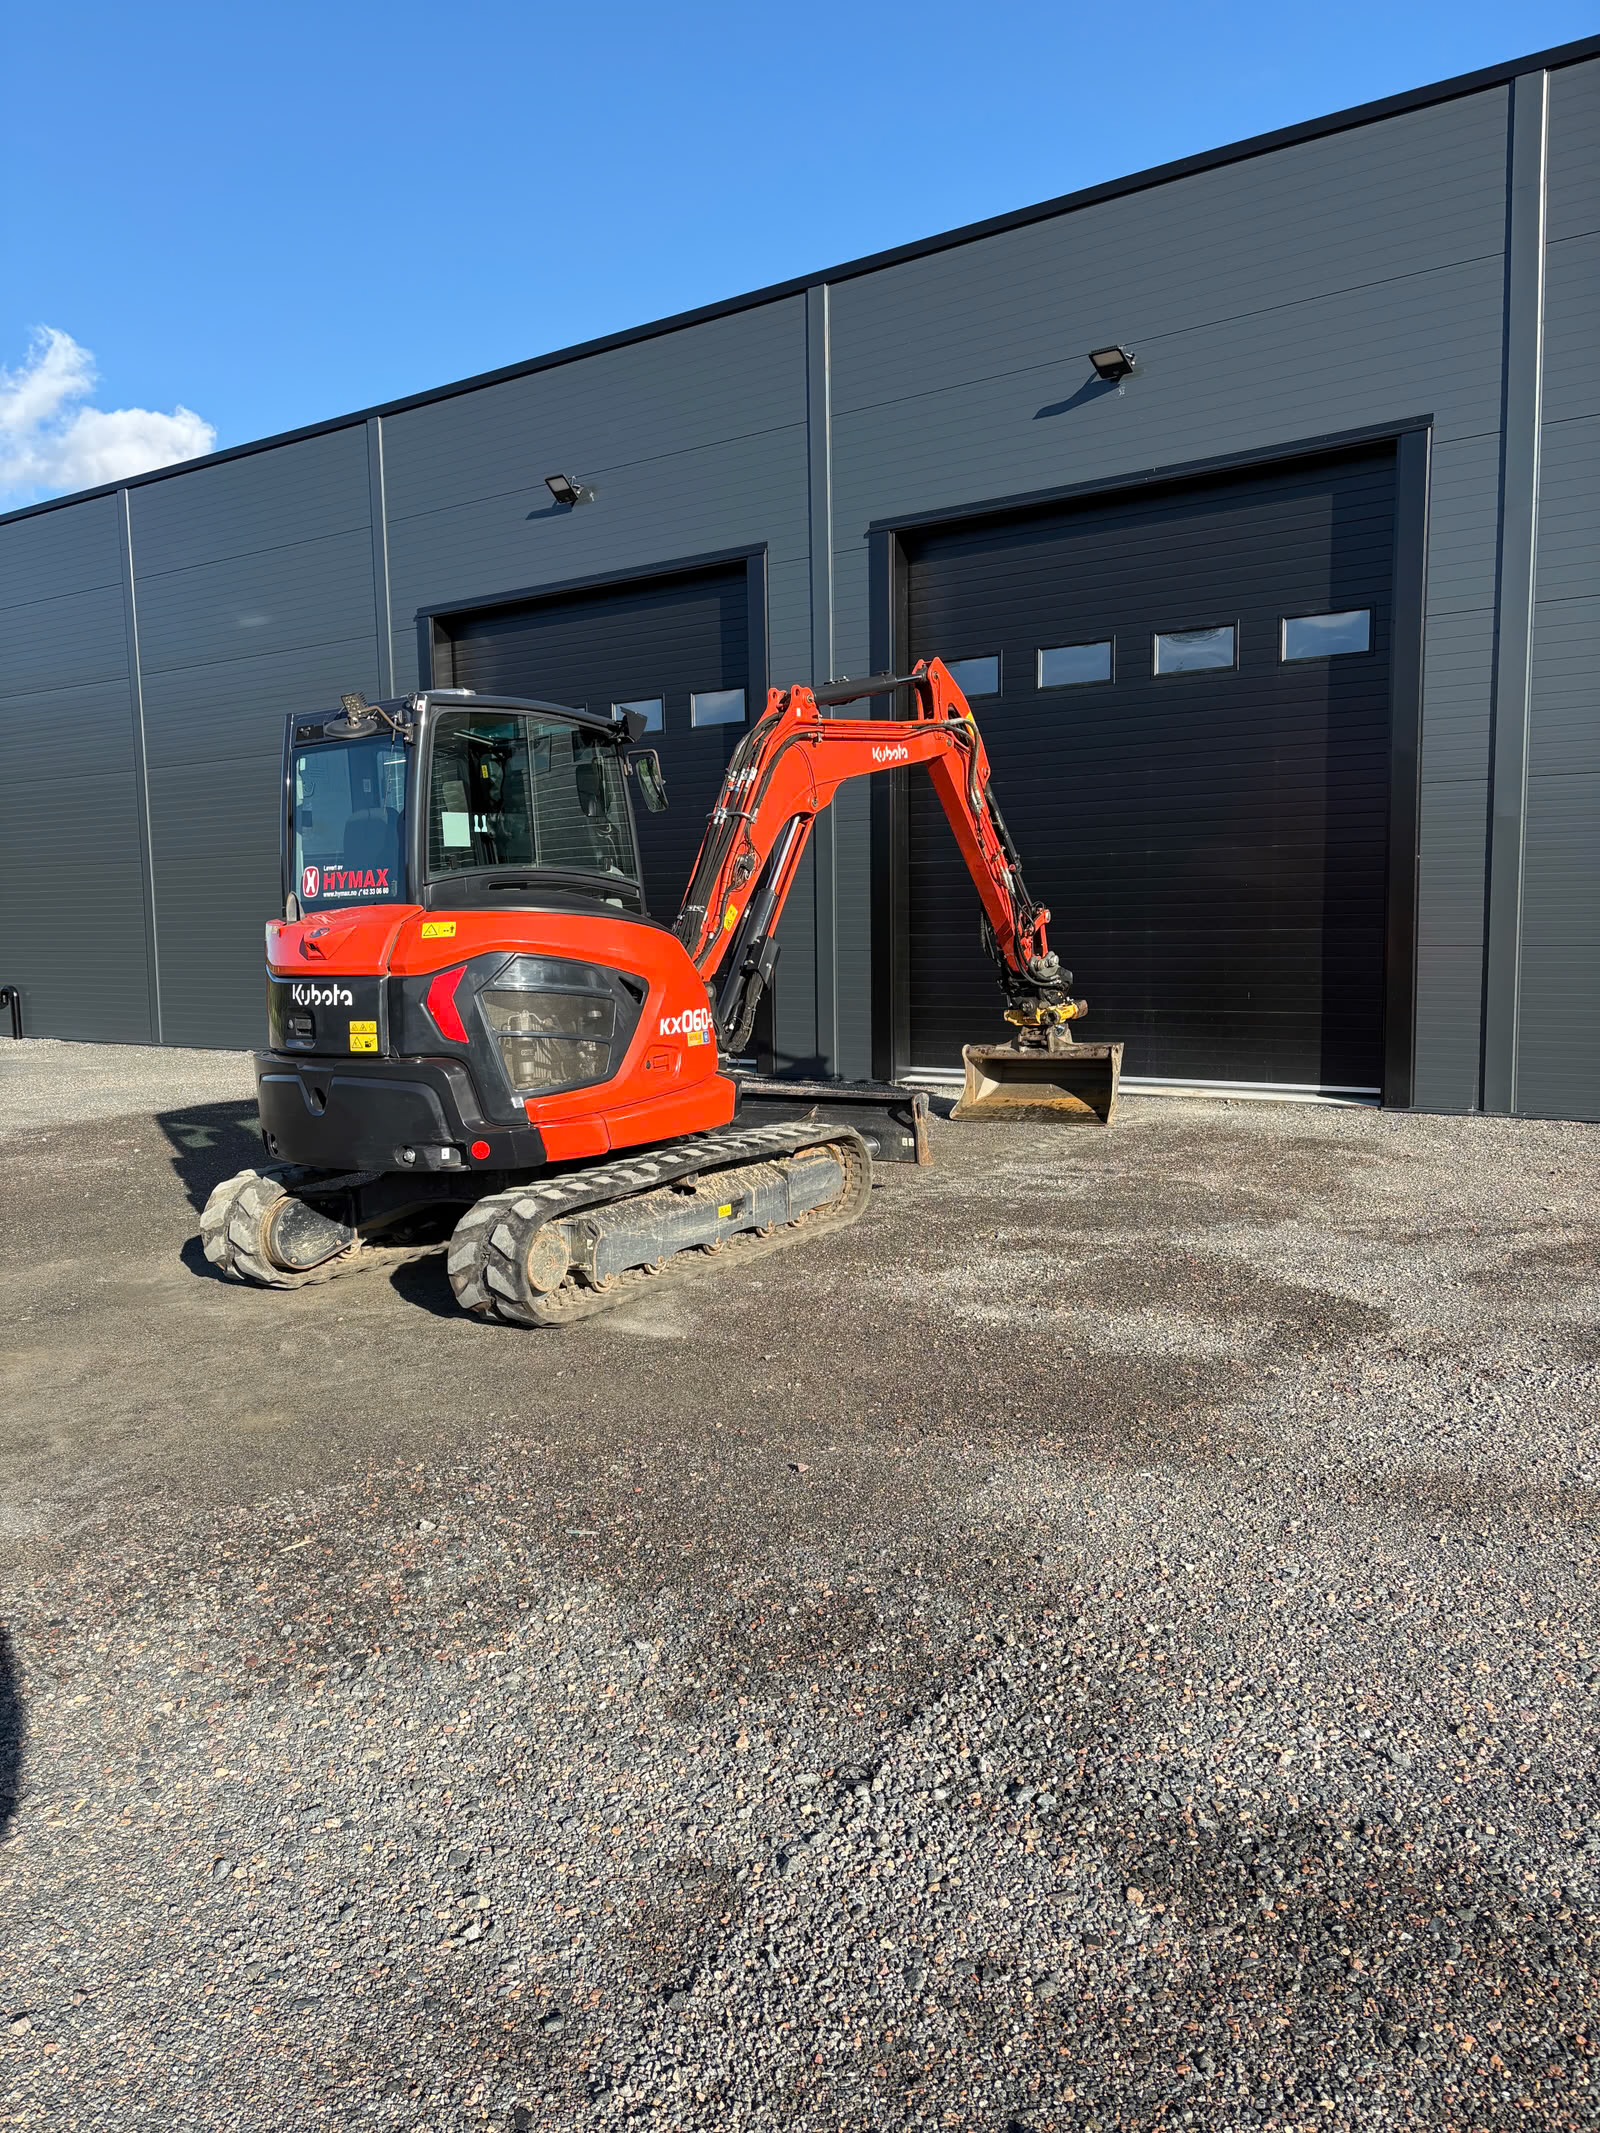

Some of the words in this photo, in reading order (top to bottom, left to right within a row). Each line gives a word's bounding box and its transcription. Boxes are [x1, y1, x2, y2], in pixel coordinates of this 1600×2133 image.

[872, 744, 908, 762] Kubota
[323, 868, 389, 890] HYMAX
[323, 890, 357, 898] www.hymax.no
[292, 984, 353, 1006] Kubota
